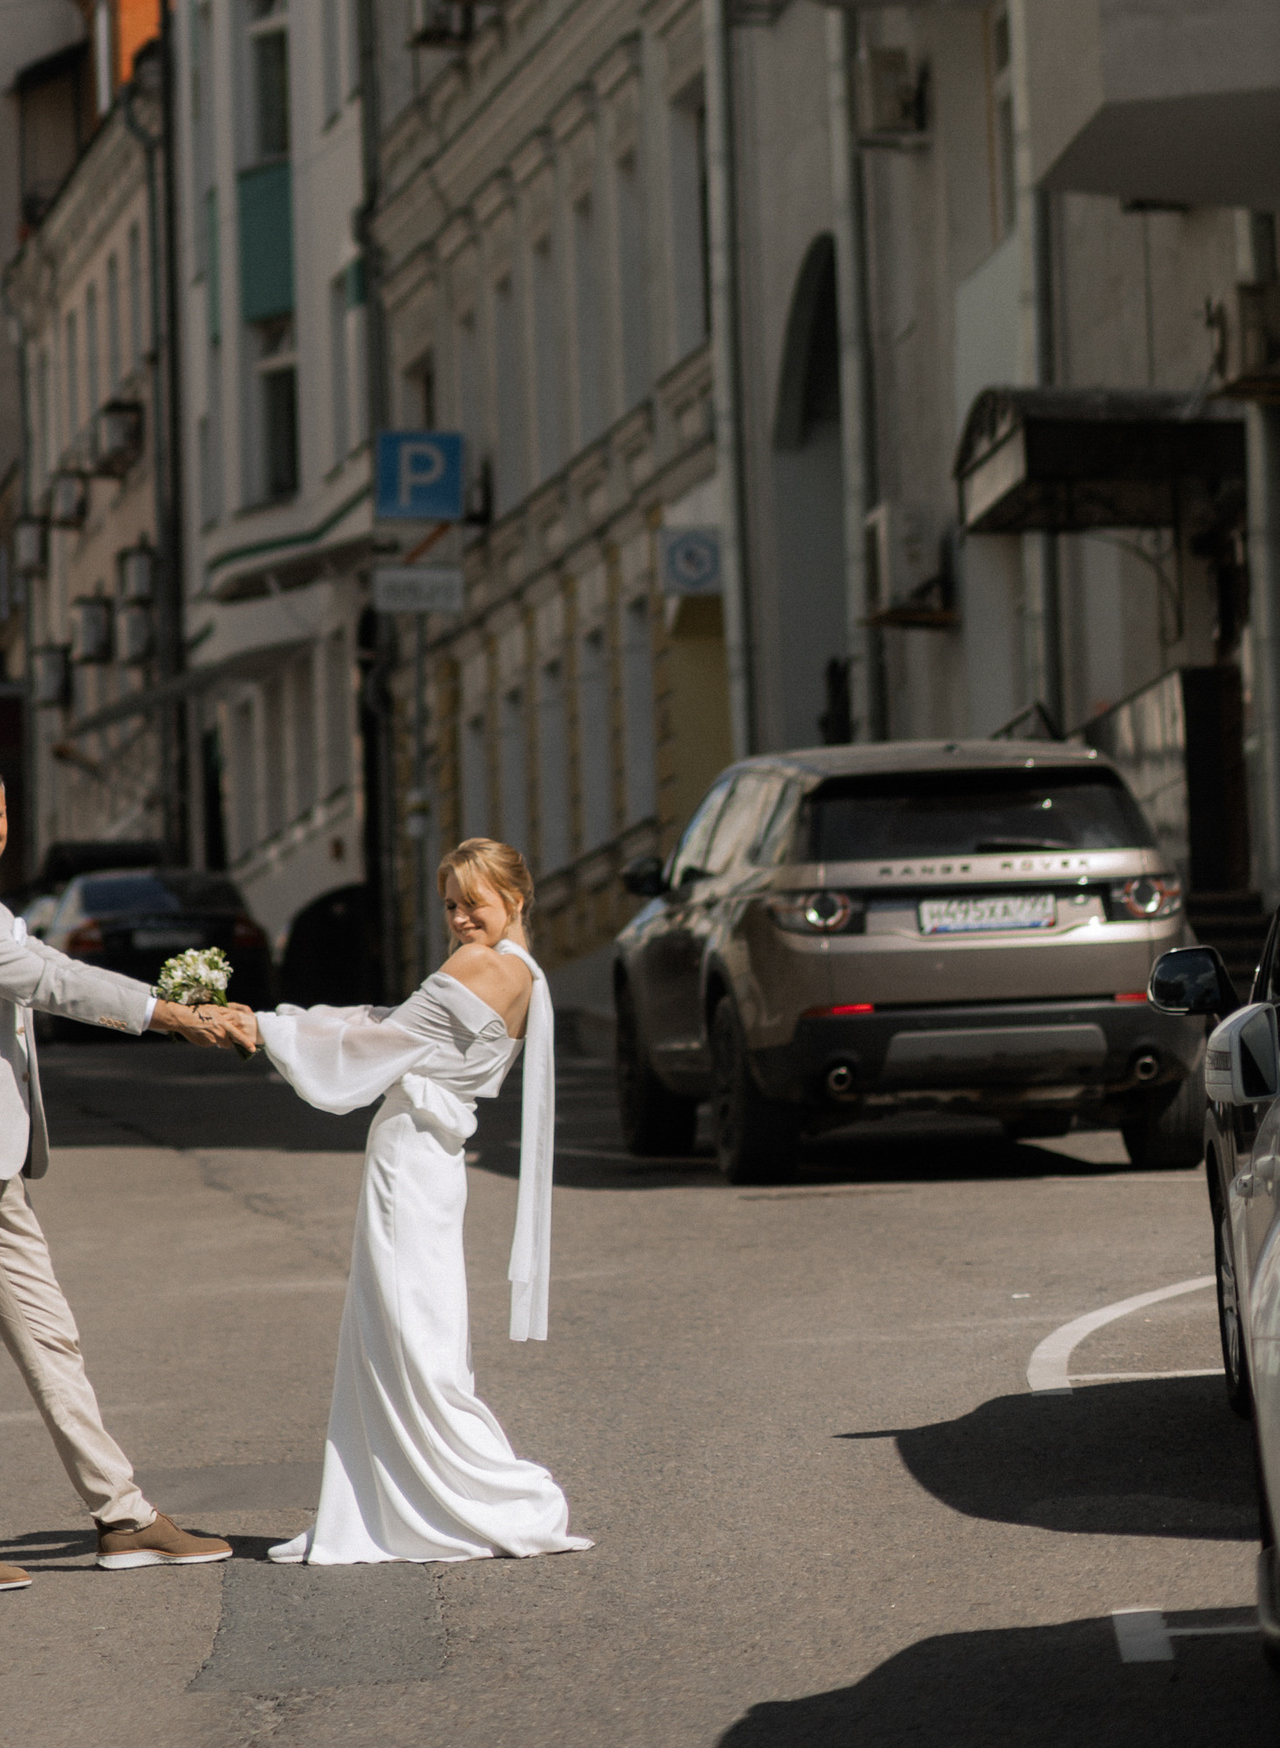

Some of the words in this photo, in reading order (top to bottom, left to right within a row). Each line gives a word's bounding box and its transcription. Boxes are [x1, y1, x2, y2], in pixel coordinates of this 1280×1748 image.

[397, 441, 446, 508] P
[879, 863, 972, 876] RANGE
[1000, 858, 1090, 871] ROVER
